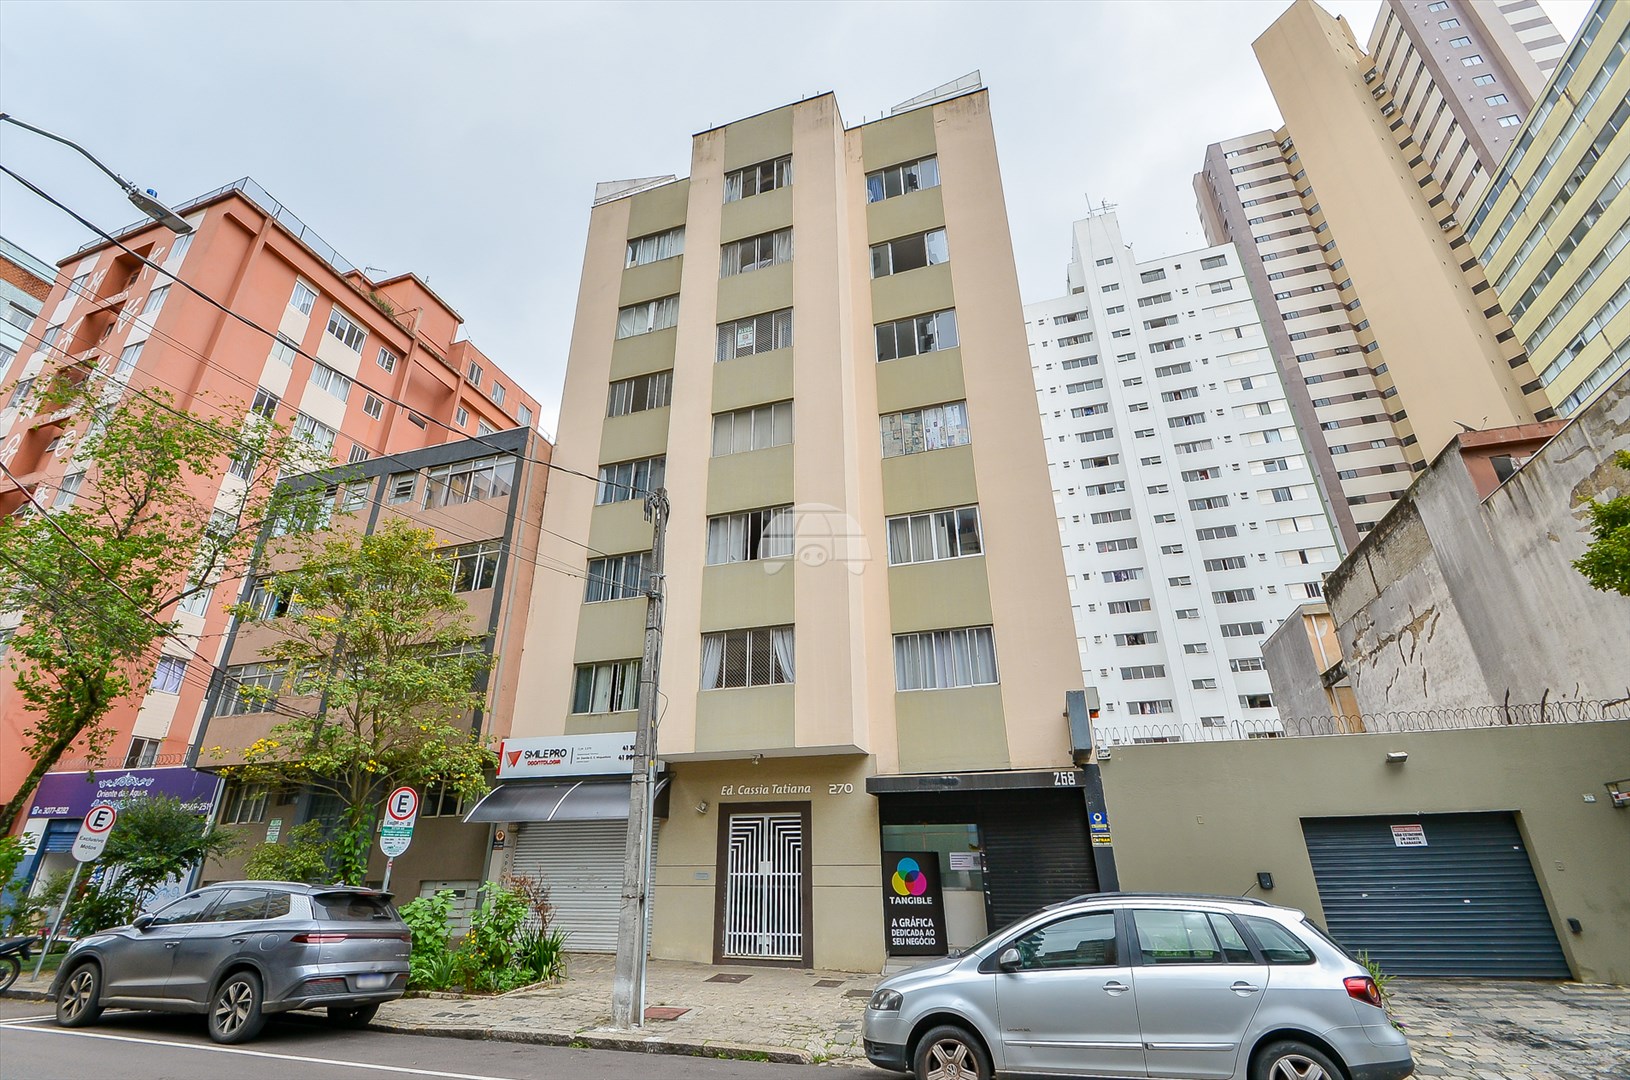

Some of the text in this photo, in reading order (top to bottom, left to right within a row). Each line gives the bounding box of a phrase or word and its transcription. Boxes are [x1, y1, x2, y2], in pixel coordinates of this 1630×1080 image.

[1053, 771, 1075, 786] 268
[97, 789, 118, 798] Oriente
[721, 784, 811, 795] Ed. Cassia Tatiana
[828, 783, 853, 794] 270
[397, 794, 409, 813] E
[93, 811, 108, 827] E
[889, 896, 933, 905] TANGIBLE
[891, 916, 934, 927] A GRÁFICA
[891, 929, 935, 937] DEDICADA AO
[892, 936, 936, 946] SEU NEGÓCIO
